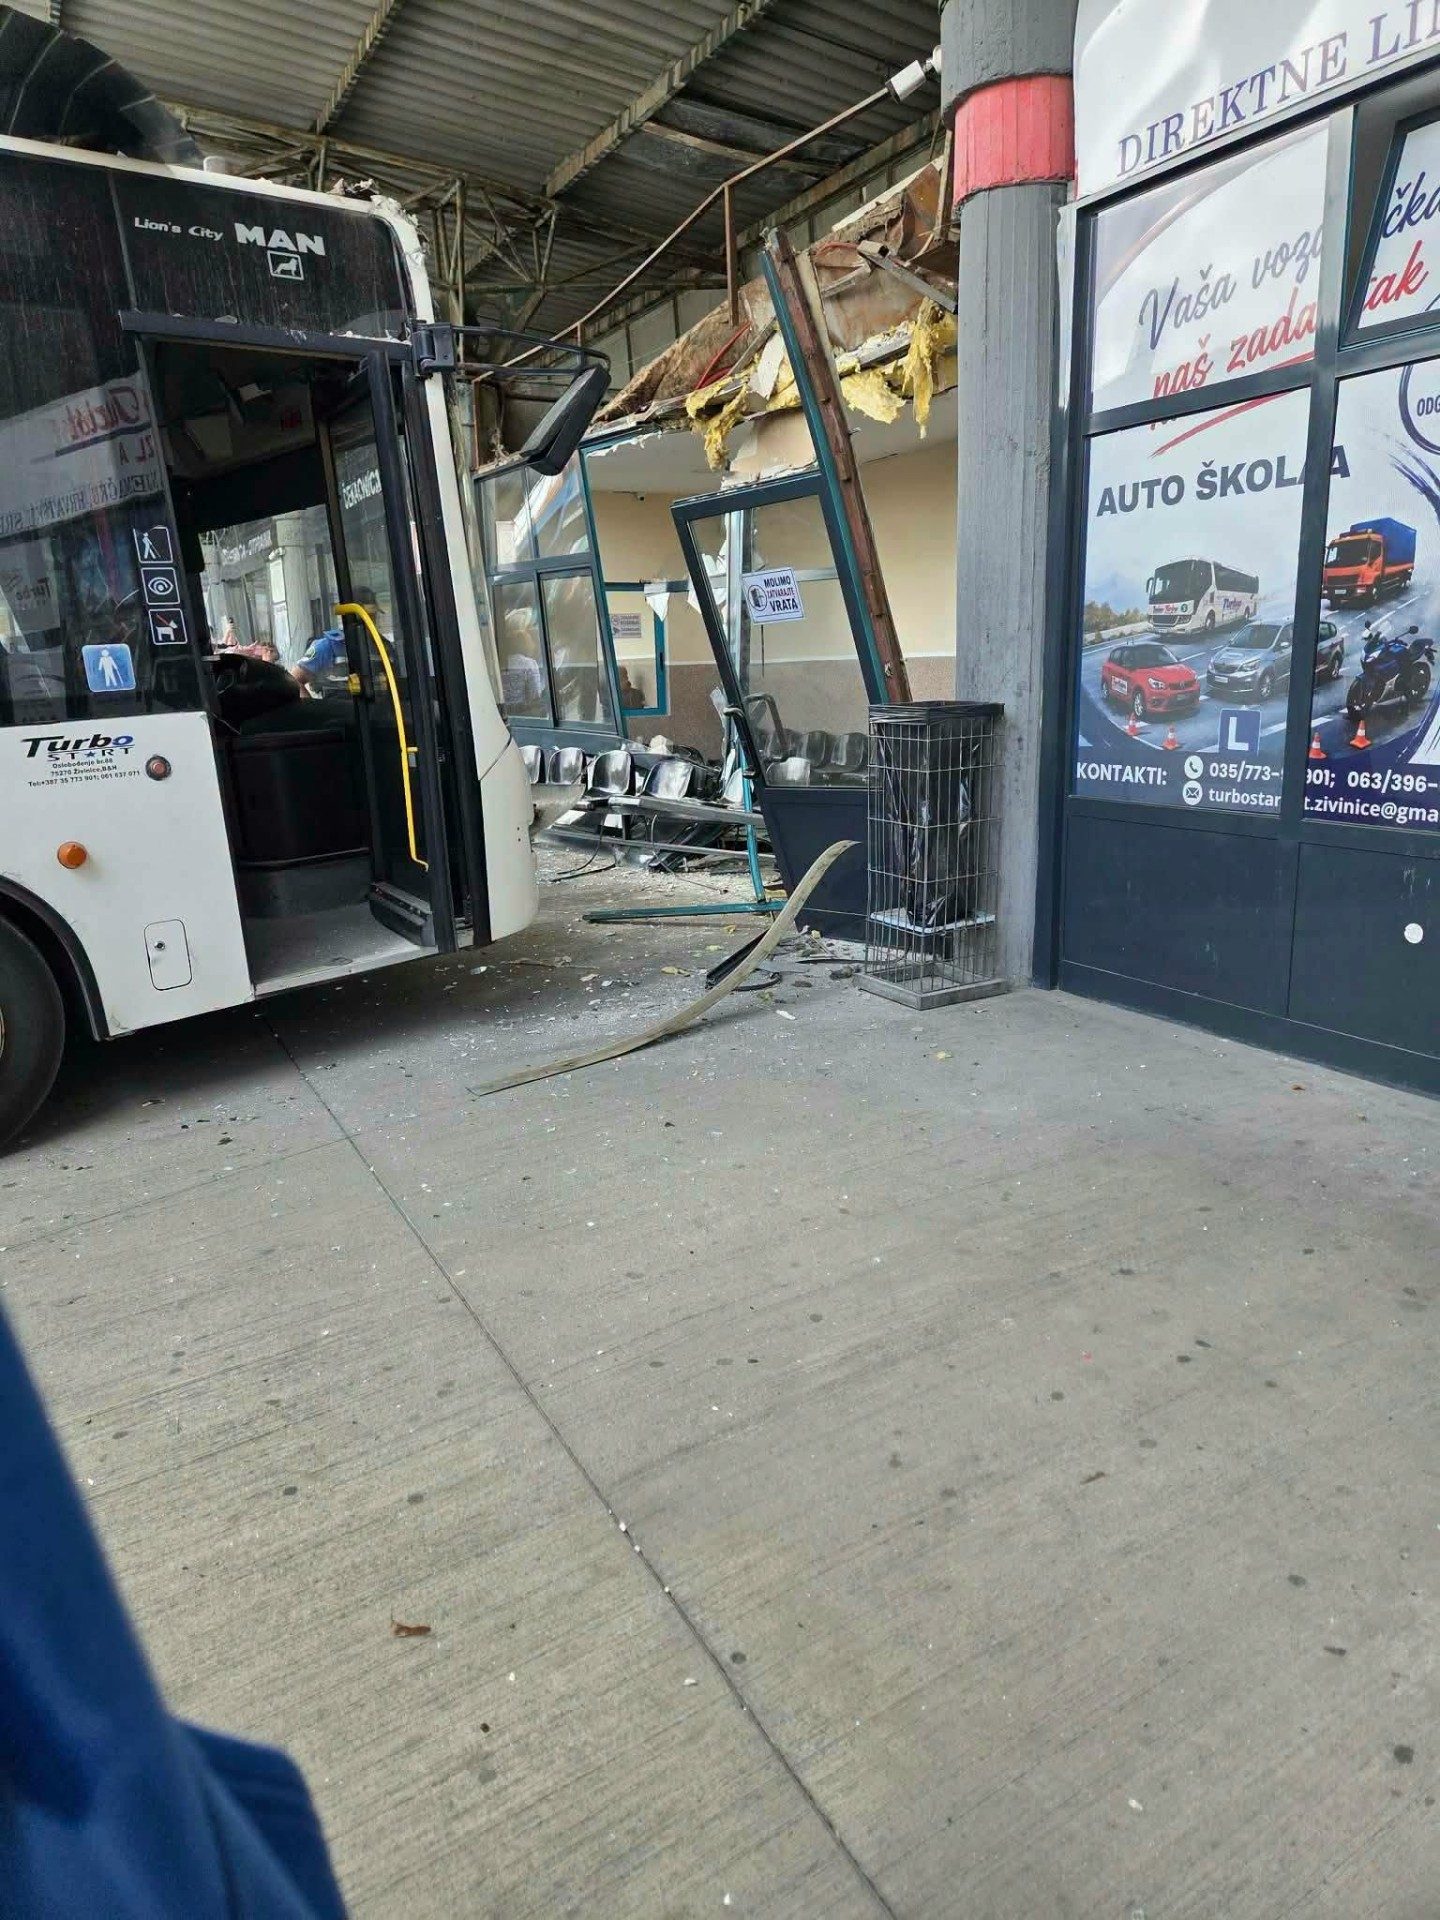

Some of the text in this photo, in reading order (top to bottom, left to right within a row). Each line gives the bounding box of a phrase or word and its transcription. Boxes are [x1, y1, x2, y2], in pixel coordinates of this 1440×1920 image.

[1117, 32, 1349, 178] DIREKTNE
[134, 217, 224, 241] Lion's City
[234, 222, 327, 256] MAN
[1138, 264, 1238, 351] Vaša
[1152, 332, 1215, 400] naš
[1096, 444, 1351, 517] AUTO ŠKOLA
[763, 575, 791, 588] MOLIMO
[769, 598, 799, 612] VRATA
[20, 733, 135, 758] Turbo
[1227, 716, 1249, 751] L
[1076, 761, 1168, 786] KONTAKTI:
